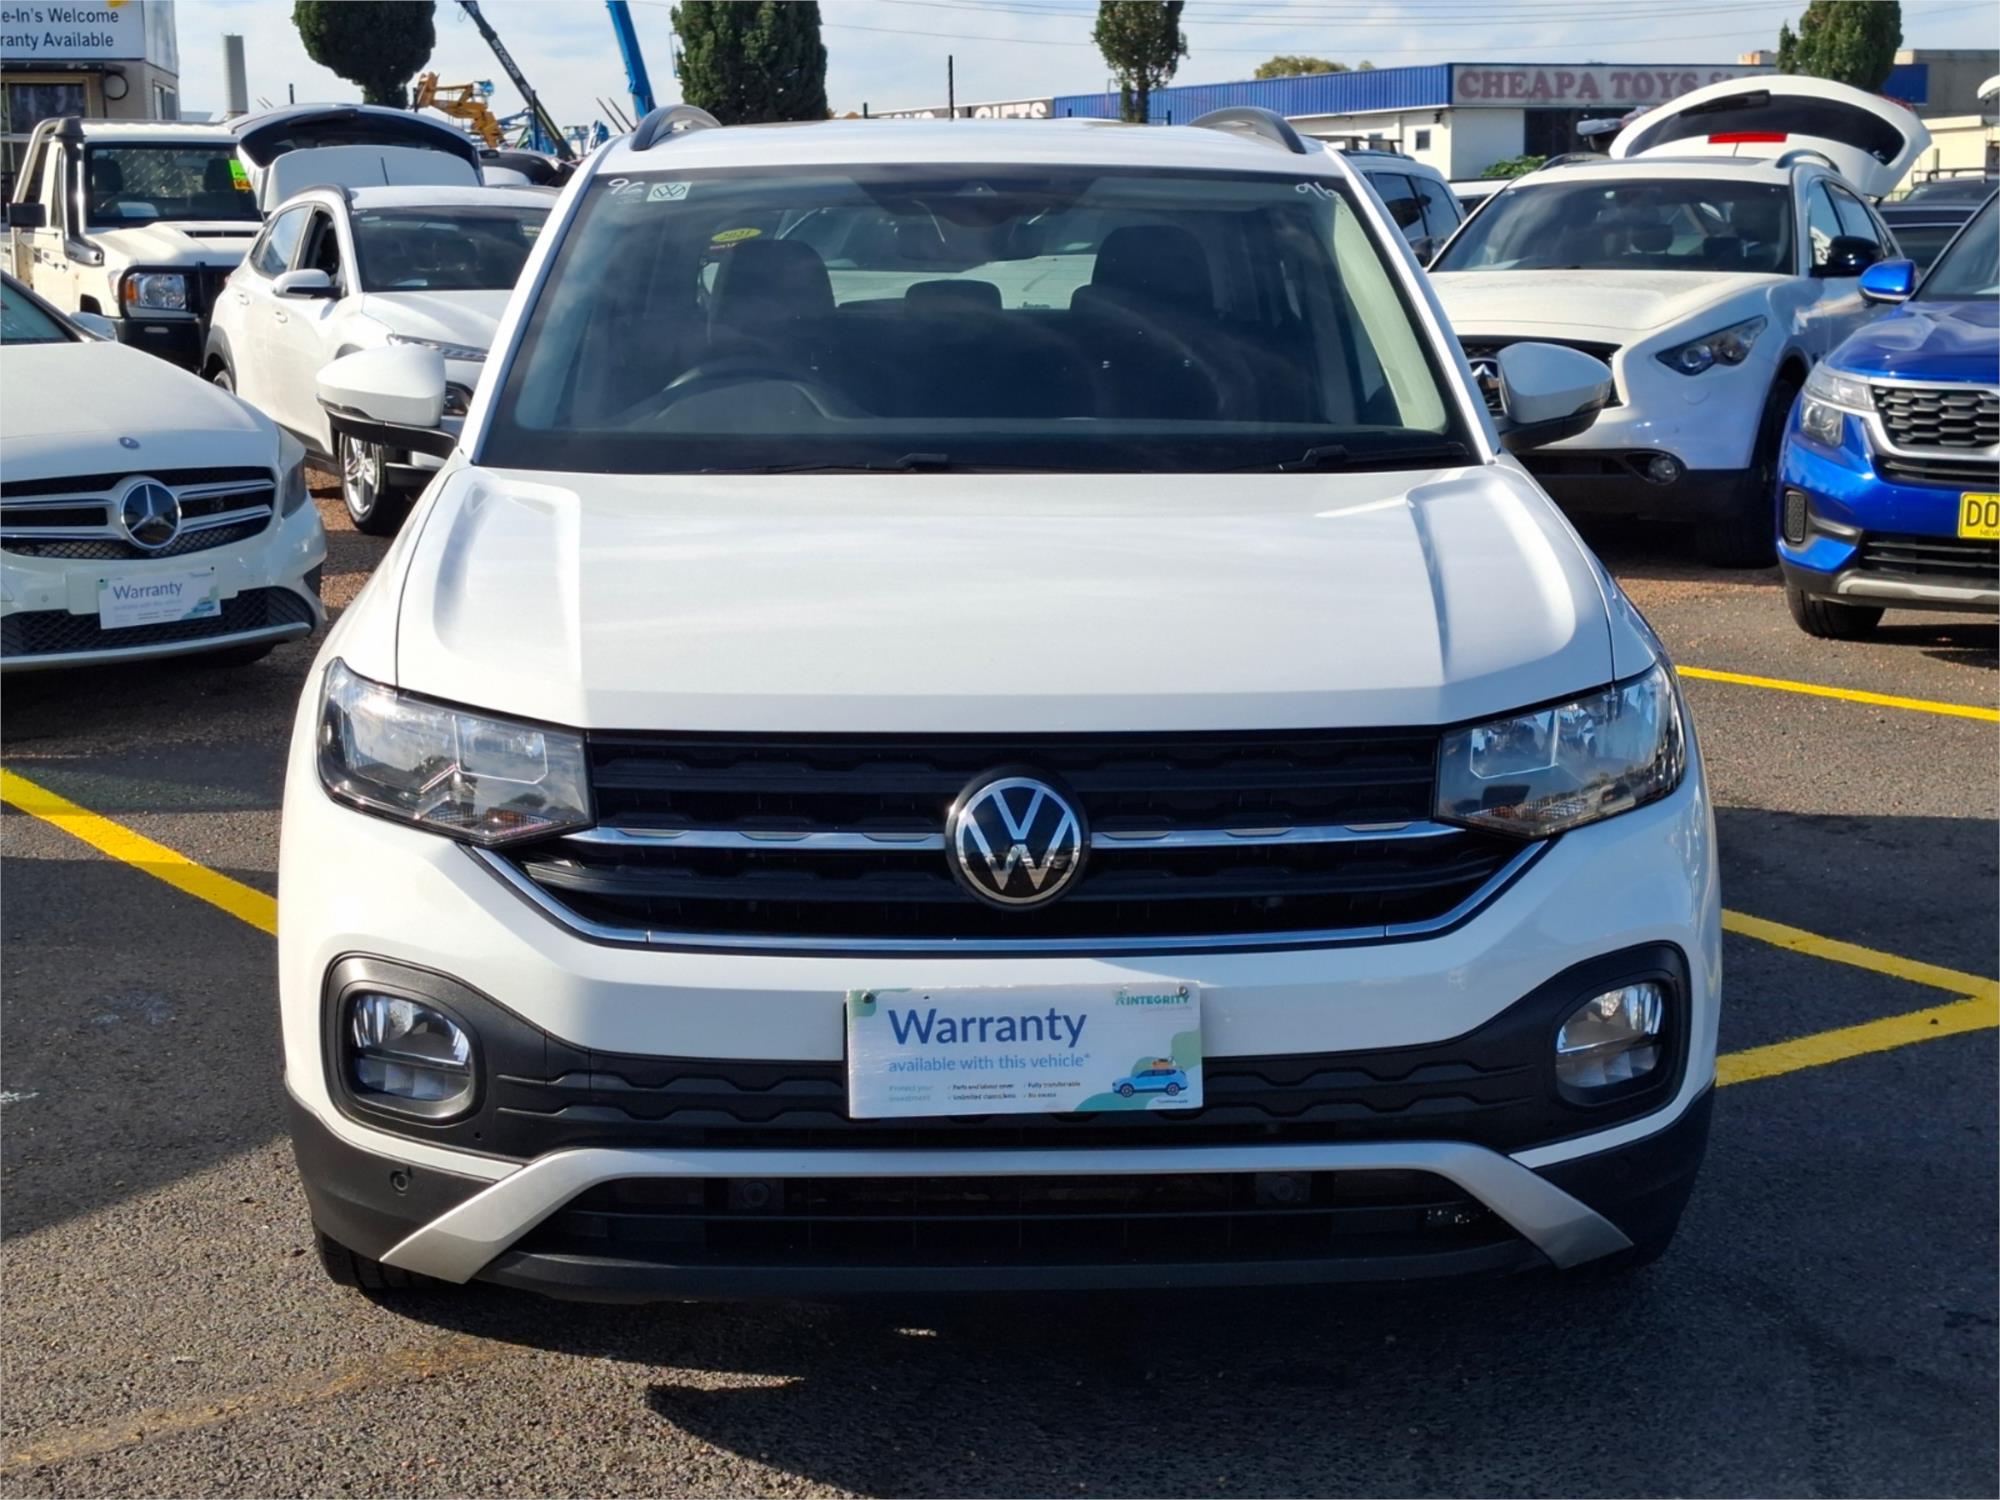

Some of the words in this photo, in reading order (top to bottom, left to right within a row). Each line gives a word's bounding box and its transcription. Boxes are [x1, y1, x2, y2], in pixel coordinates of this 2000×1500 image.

[49, 8, 119, 23] Welcome
[43, 32, 114, 47] Available
[1457, 70, 1601, 100] CHEAPA
[112, 582, 183, 601] Warranty
[1126, 994, 1190, 1006] INTEGRITY
[888, 1007, 1087, 1048] Warranty
[888, 1057, 956, 1072] available
[959, 1056, 994, 1071] with
[999, 1055, 1027, 1069] this
